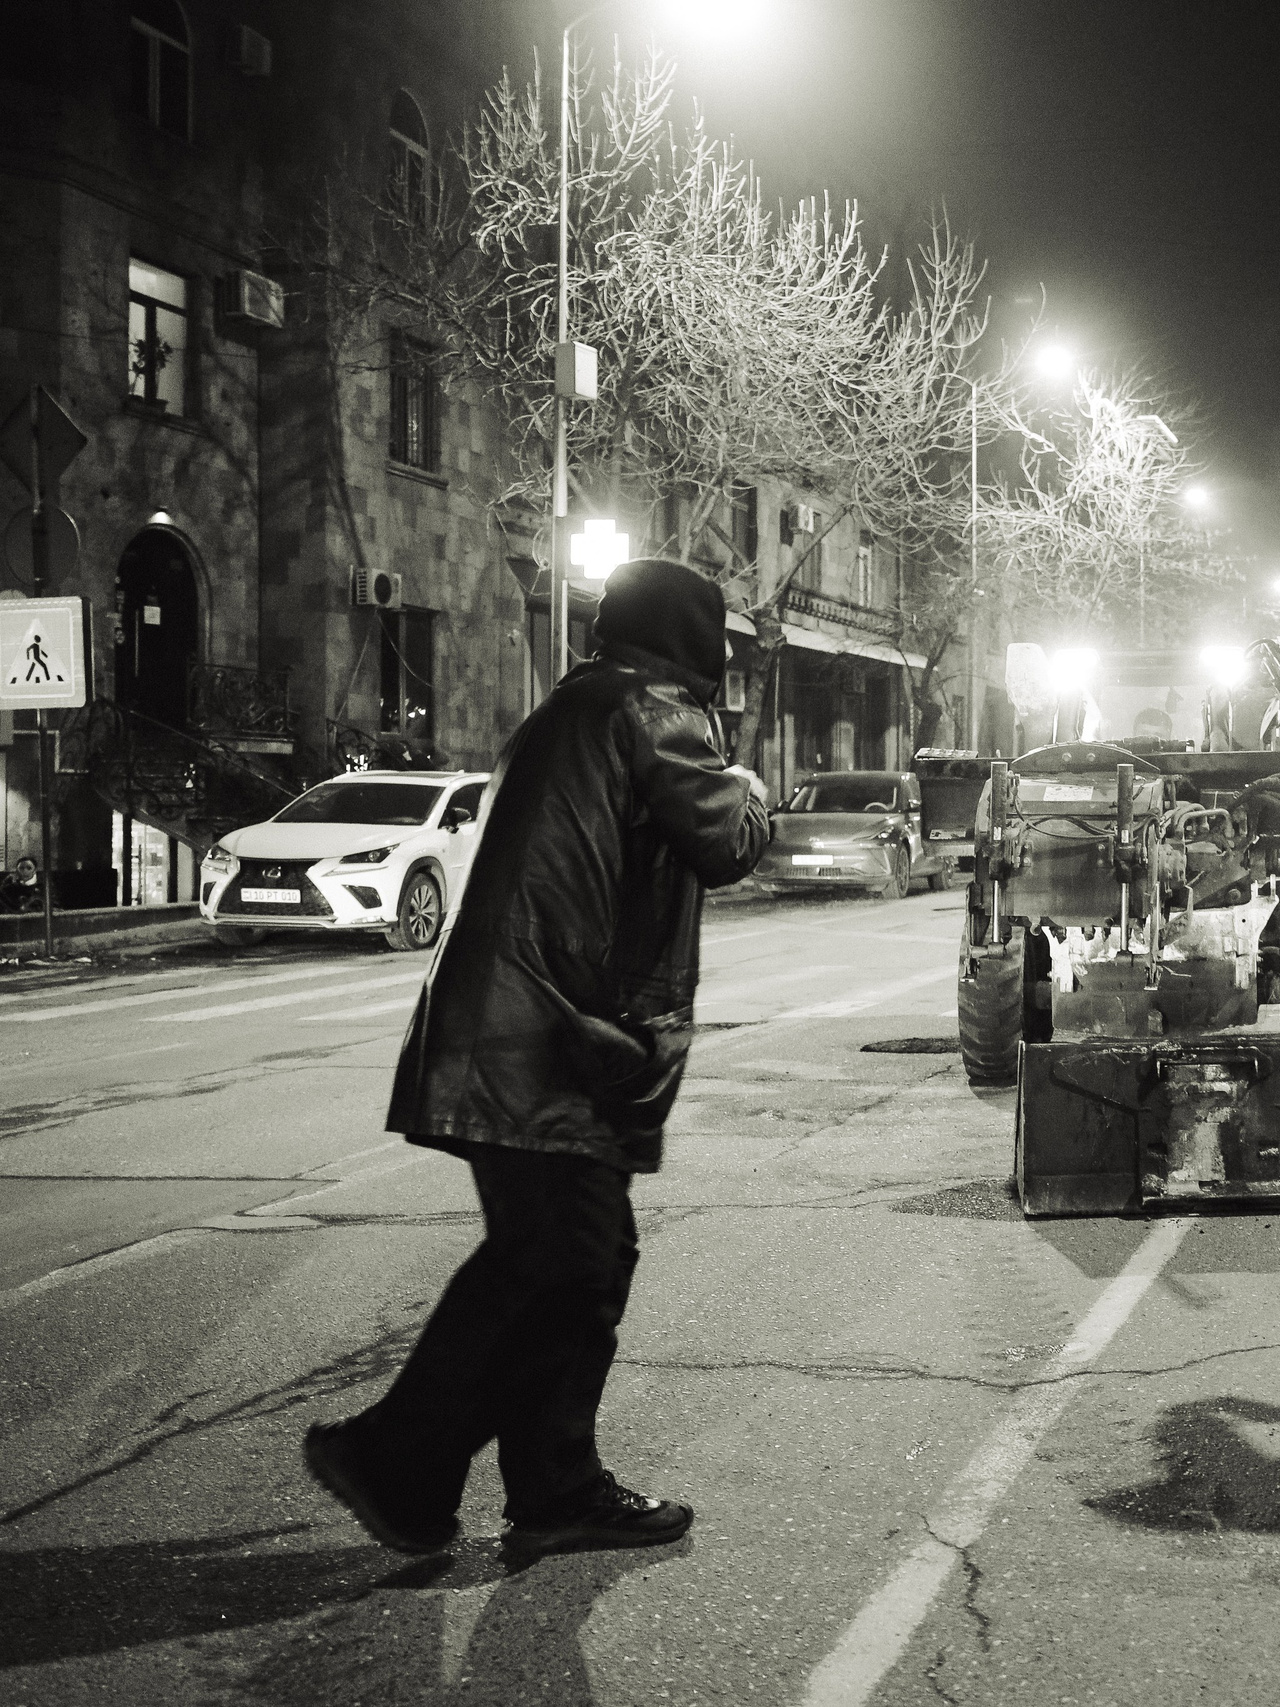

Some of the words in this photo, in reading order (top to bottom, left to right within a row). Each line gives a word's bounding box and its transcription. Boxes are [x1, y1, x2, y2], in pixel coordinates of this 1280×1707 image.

[254, 890, 264, 900] 10
[266, 890, 278, 901] PT
[281, 891, 298, 901] 010
